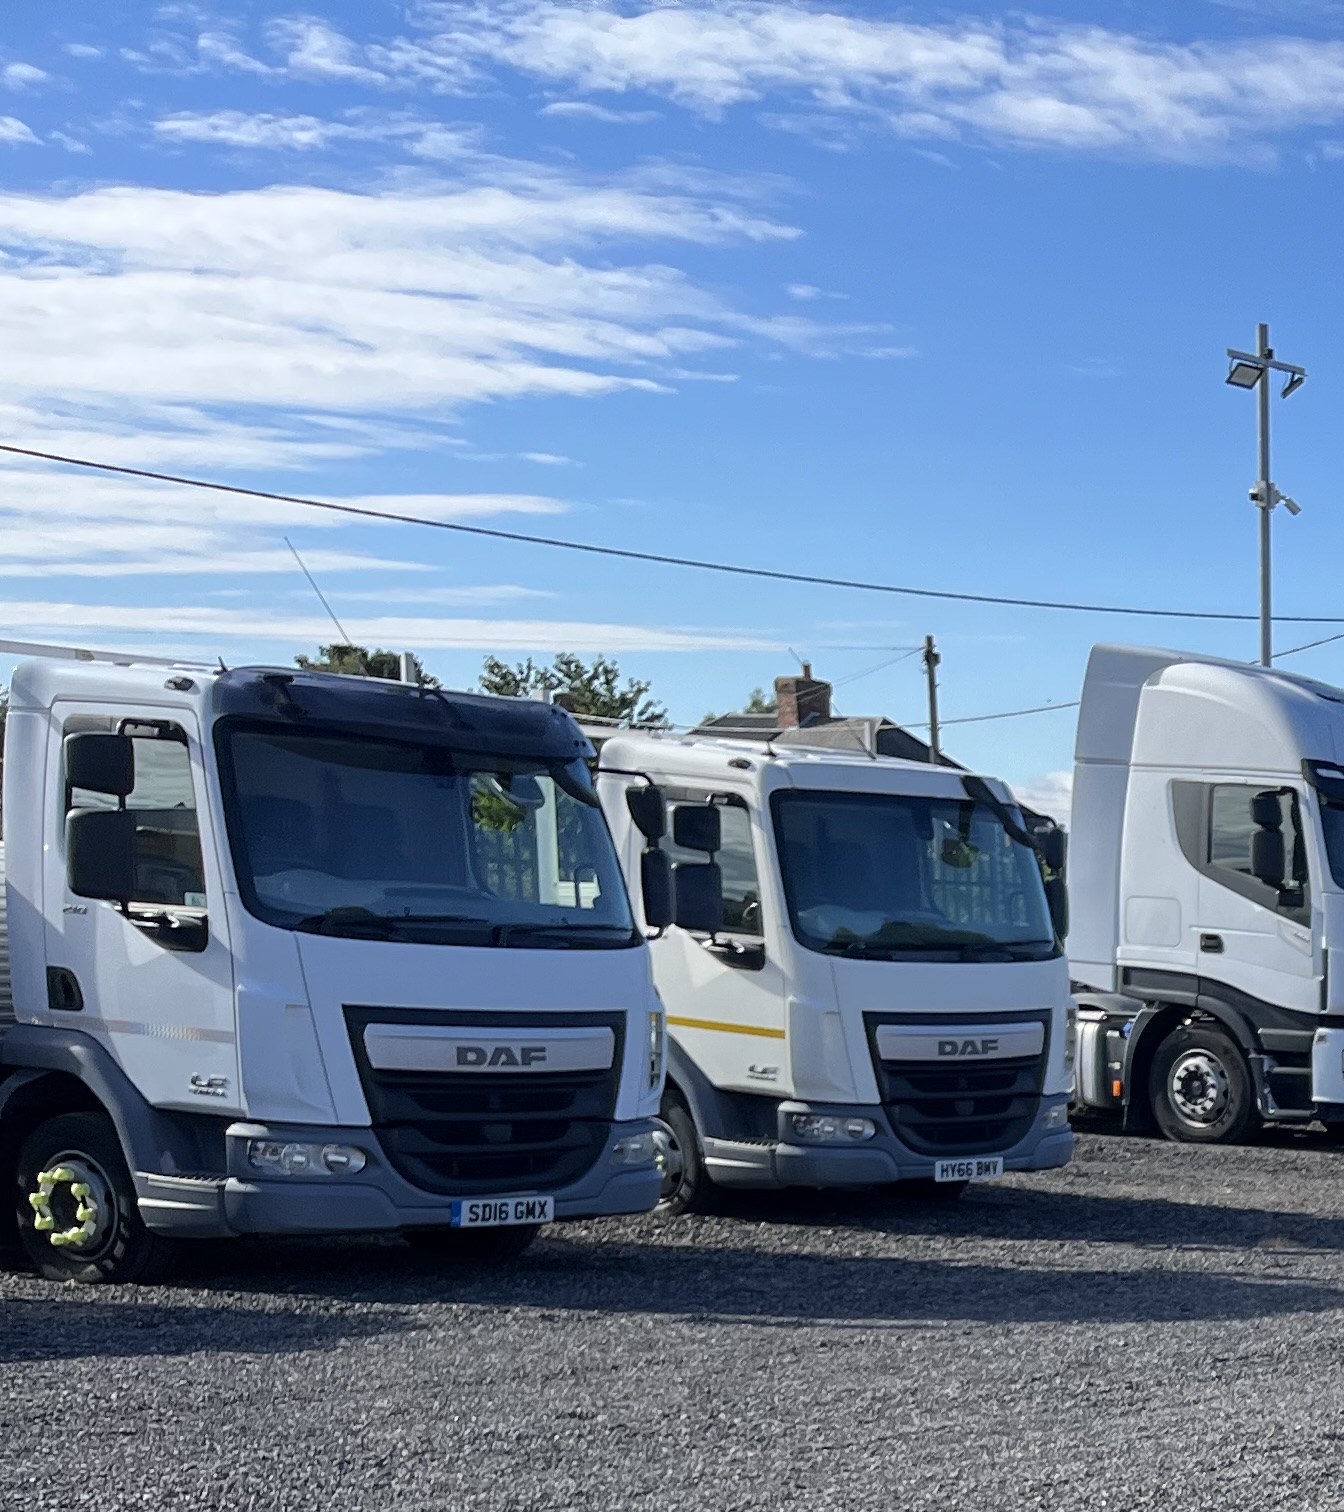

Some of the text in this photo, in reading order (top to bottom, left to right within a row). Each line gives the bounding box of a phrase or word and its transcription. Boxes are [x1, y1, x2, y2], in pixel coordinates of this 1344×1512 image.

[457, 1046, 547, 1067] DAF
[938, 1039, 999, 1056] DAF
[468, 1200, 548, 1223] SD16 GMX
